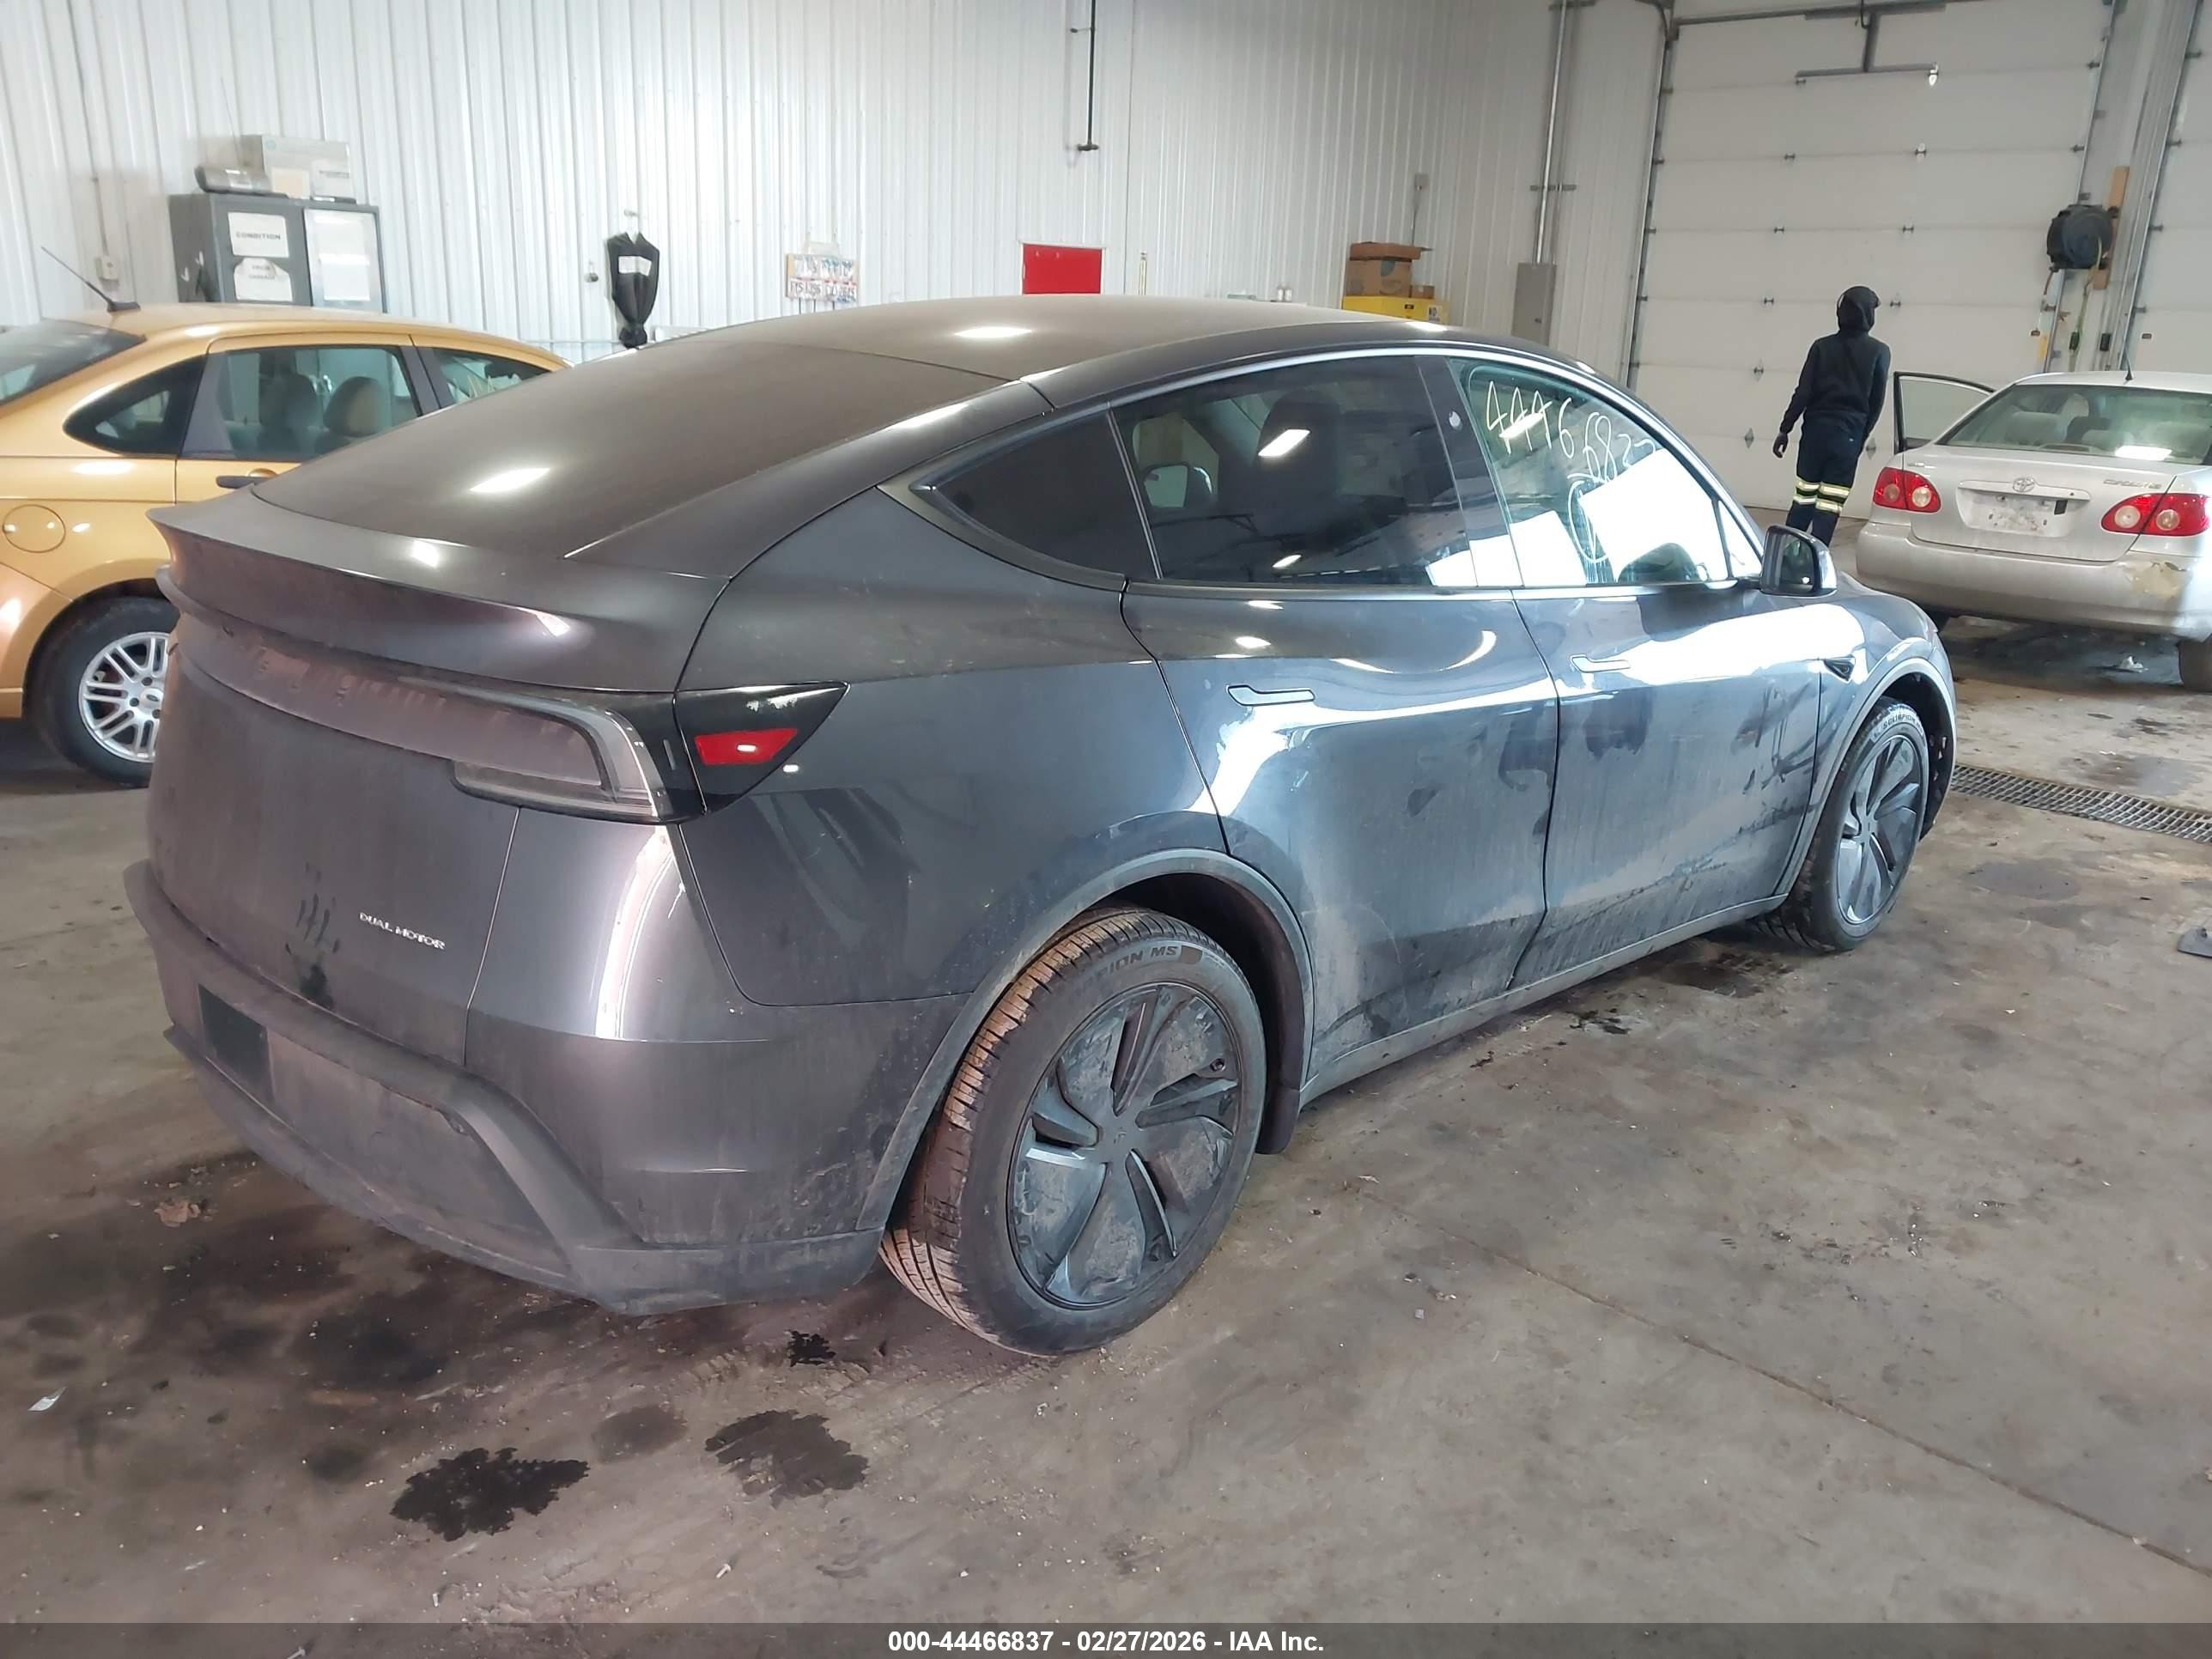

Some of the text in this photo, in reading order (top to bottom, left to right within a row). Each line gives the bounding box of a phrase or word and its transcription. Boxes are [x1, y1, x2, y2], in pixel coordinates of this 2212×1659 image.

[235, 232, 282, 240] CONDITION
[359, 912, 447, 951] DUAL MOTOR
[1150, 945, 1178, 958] MS
